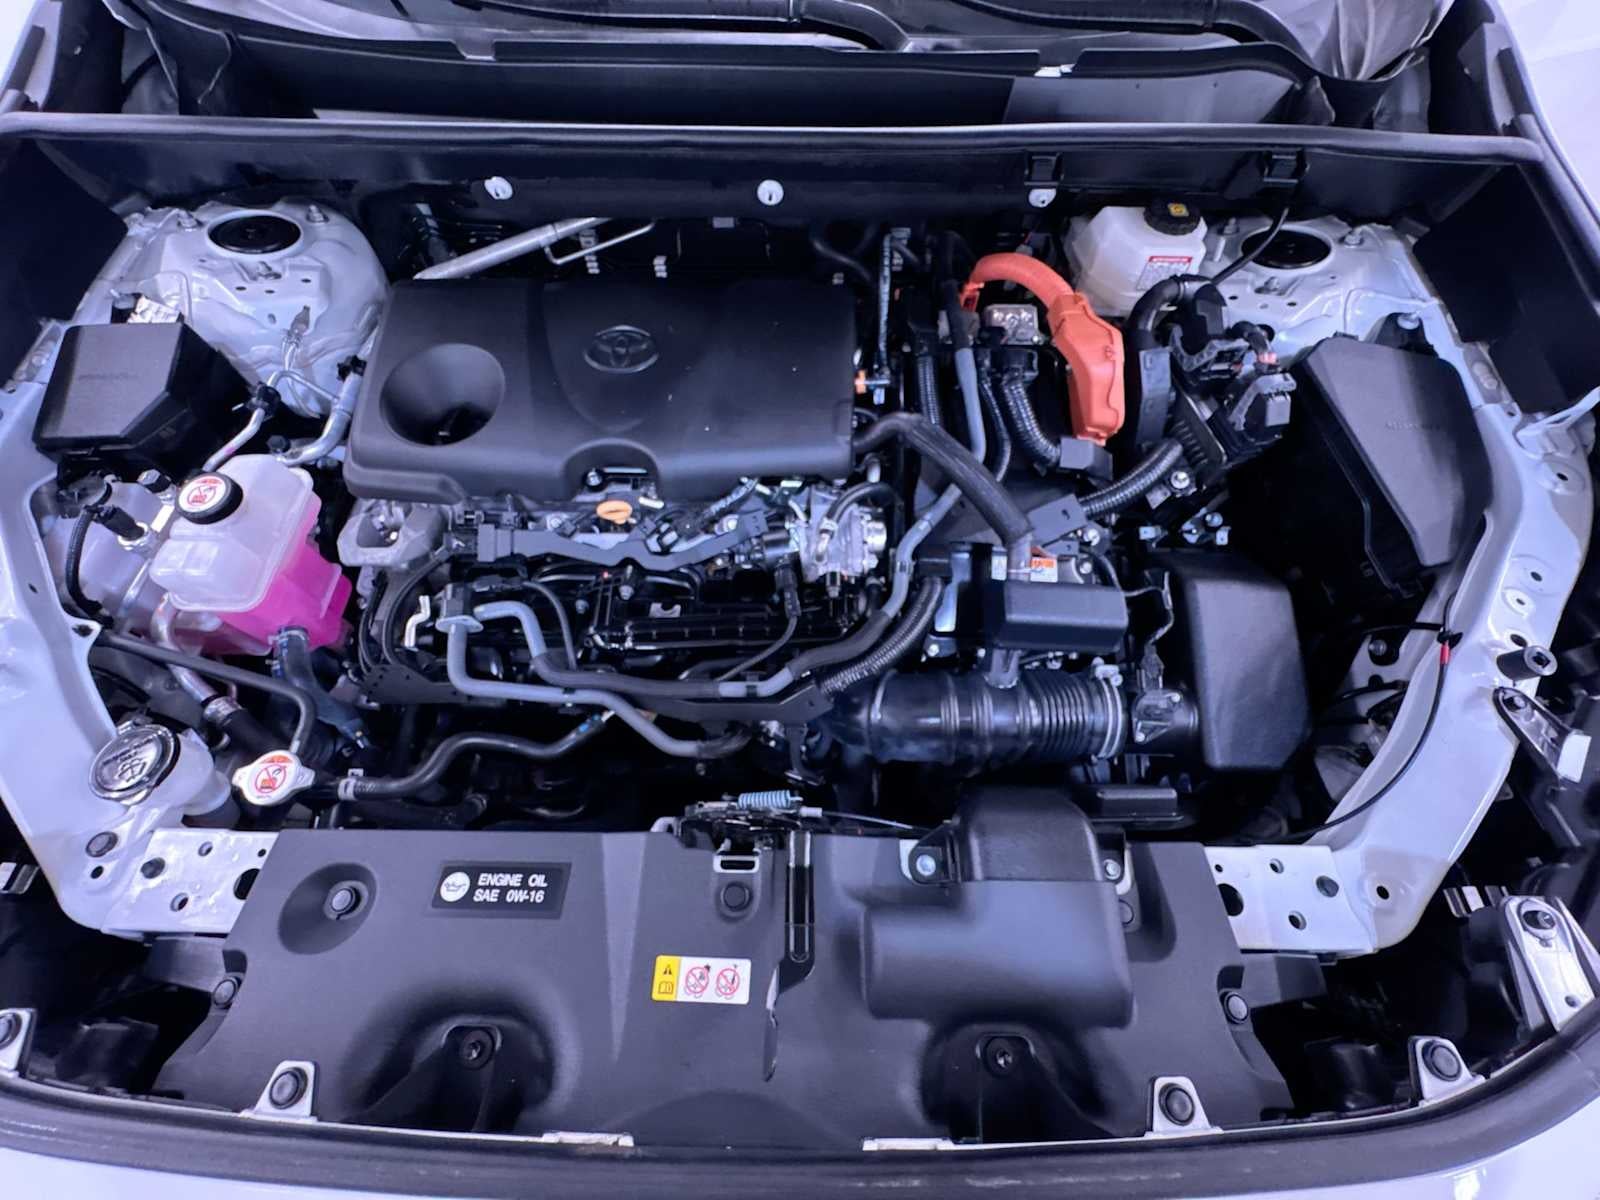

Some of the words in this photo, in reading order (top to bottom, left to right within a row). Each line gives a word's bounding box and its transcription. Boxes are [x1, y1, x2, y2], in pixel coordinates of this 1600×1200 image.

[478, 873, 523, 887] ENGINE
[527, 874, 548, 888] OIL
[473, 888, 500, 902] SAE
[505, 889, 545, 903] 0W-16
